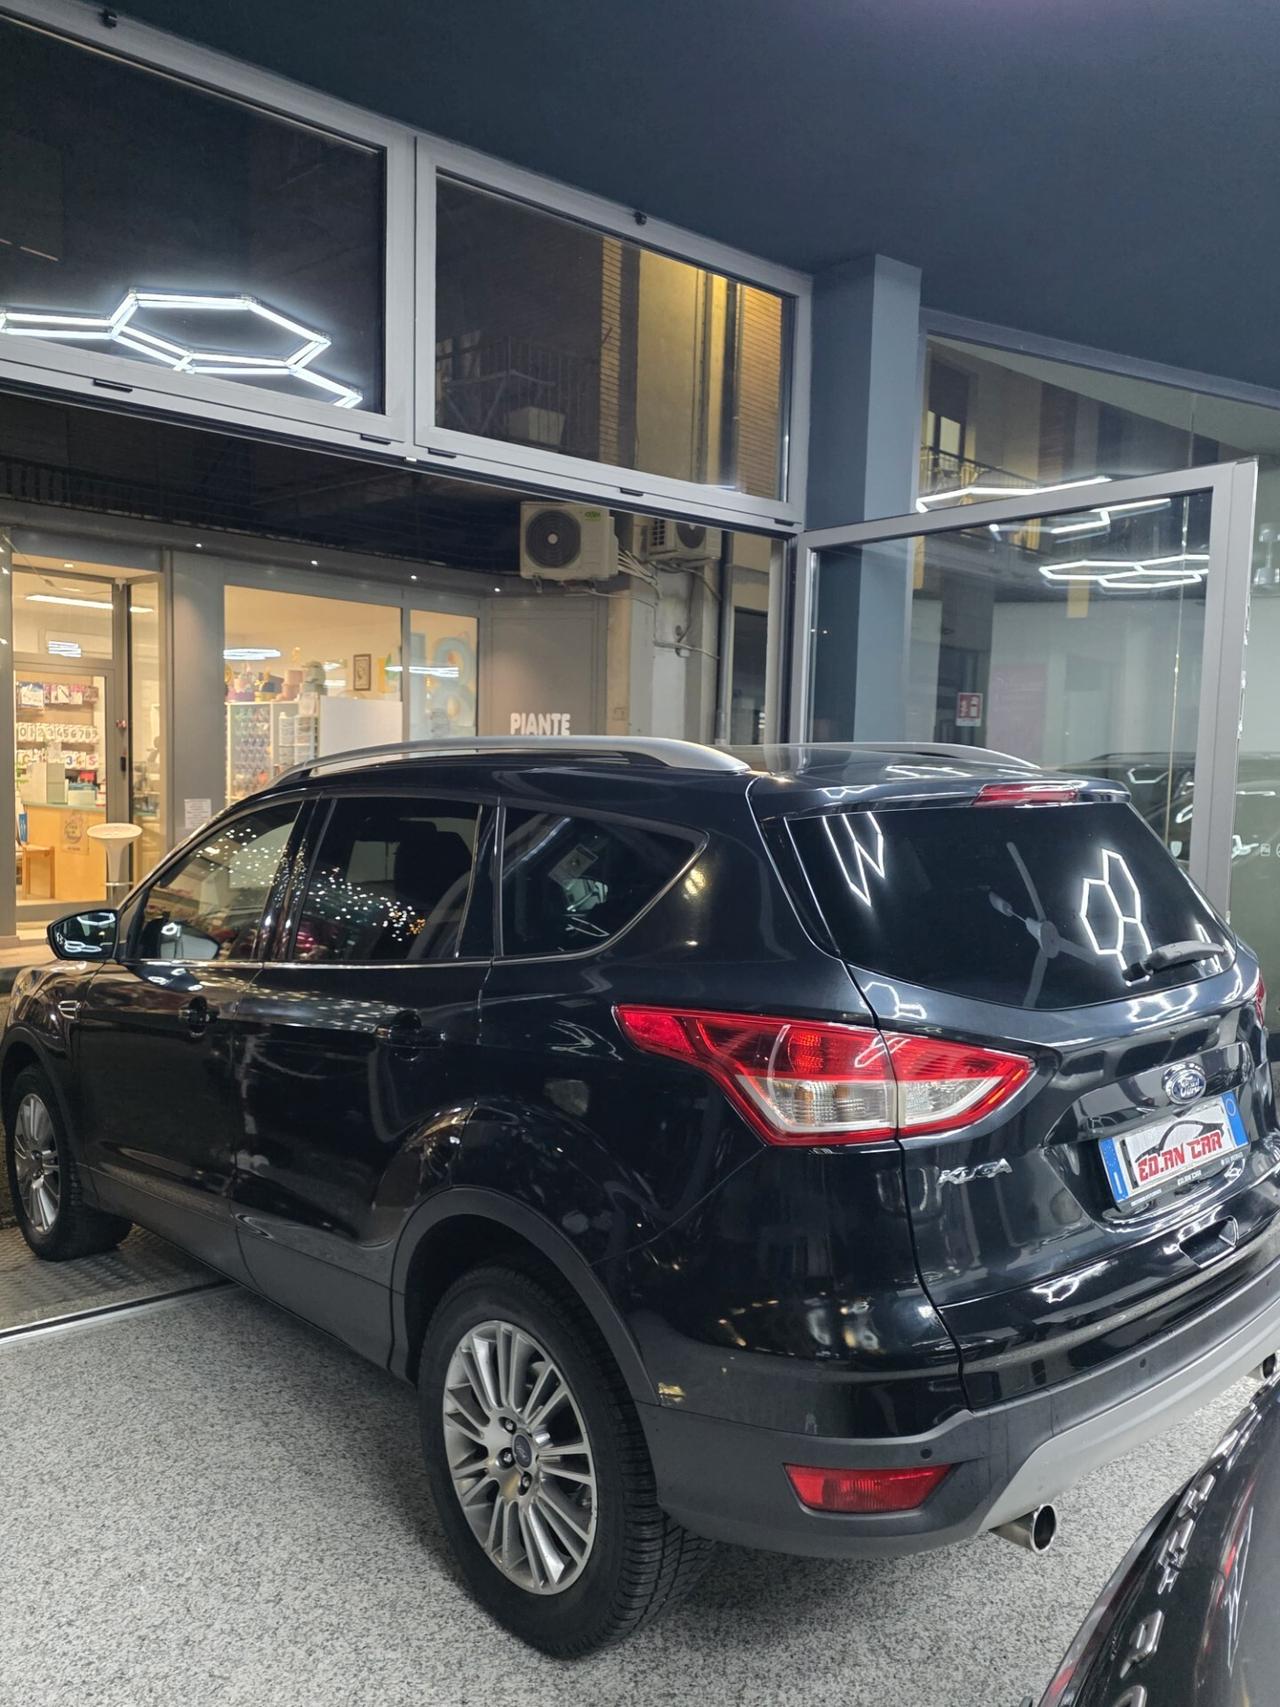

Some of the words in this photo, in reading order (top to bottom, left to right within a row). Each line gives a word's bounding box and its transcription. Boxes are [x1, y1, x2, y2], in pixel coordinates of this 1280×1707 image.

[510, 712, 571, 736] PIANTE
[1187, 1130, 1223, 1160] CAR
[937, 1158, 1013, 1185] KUGA
